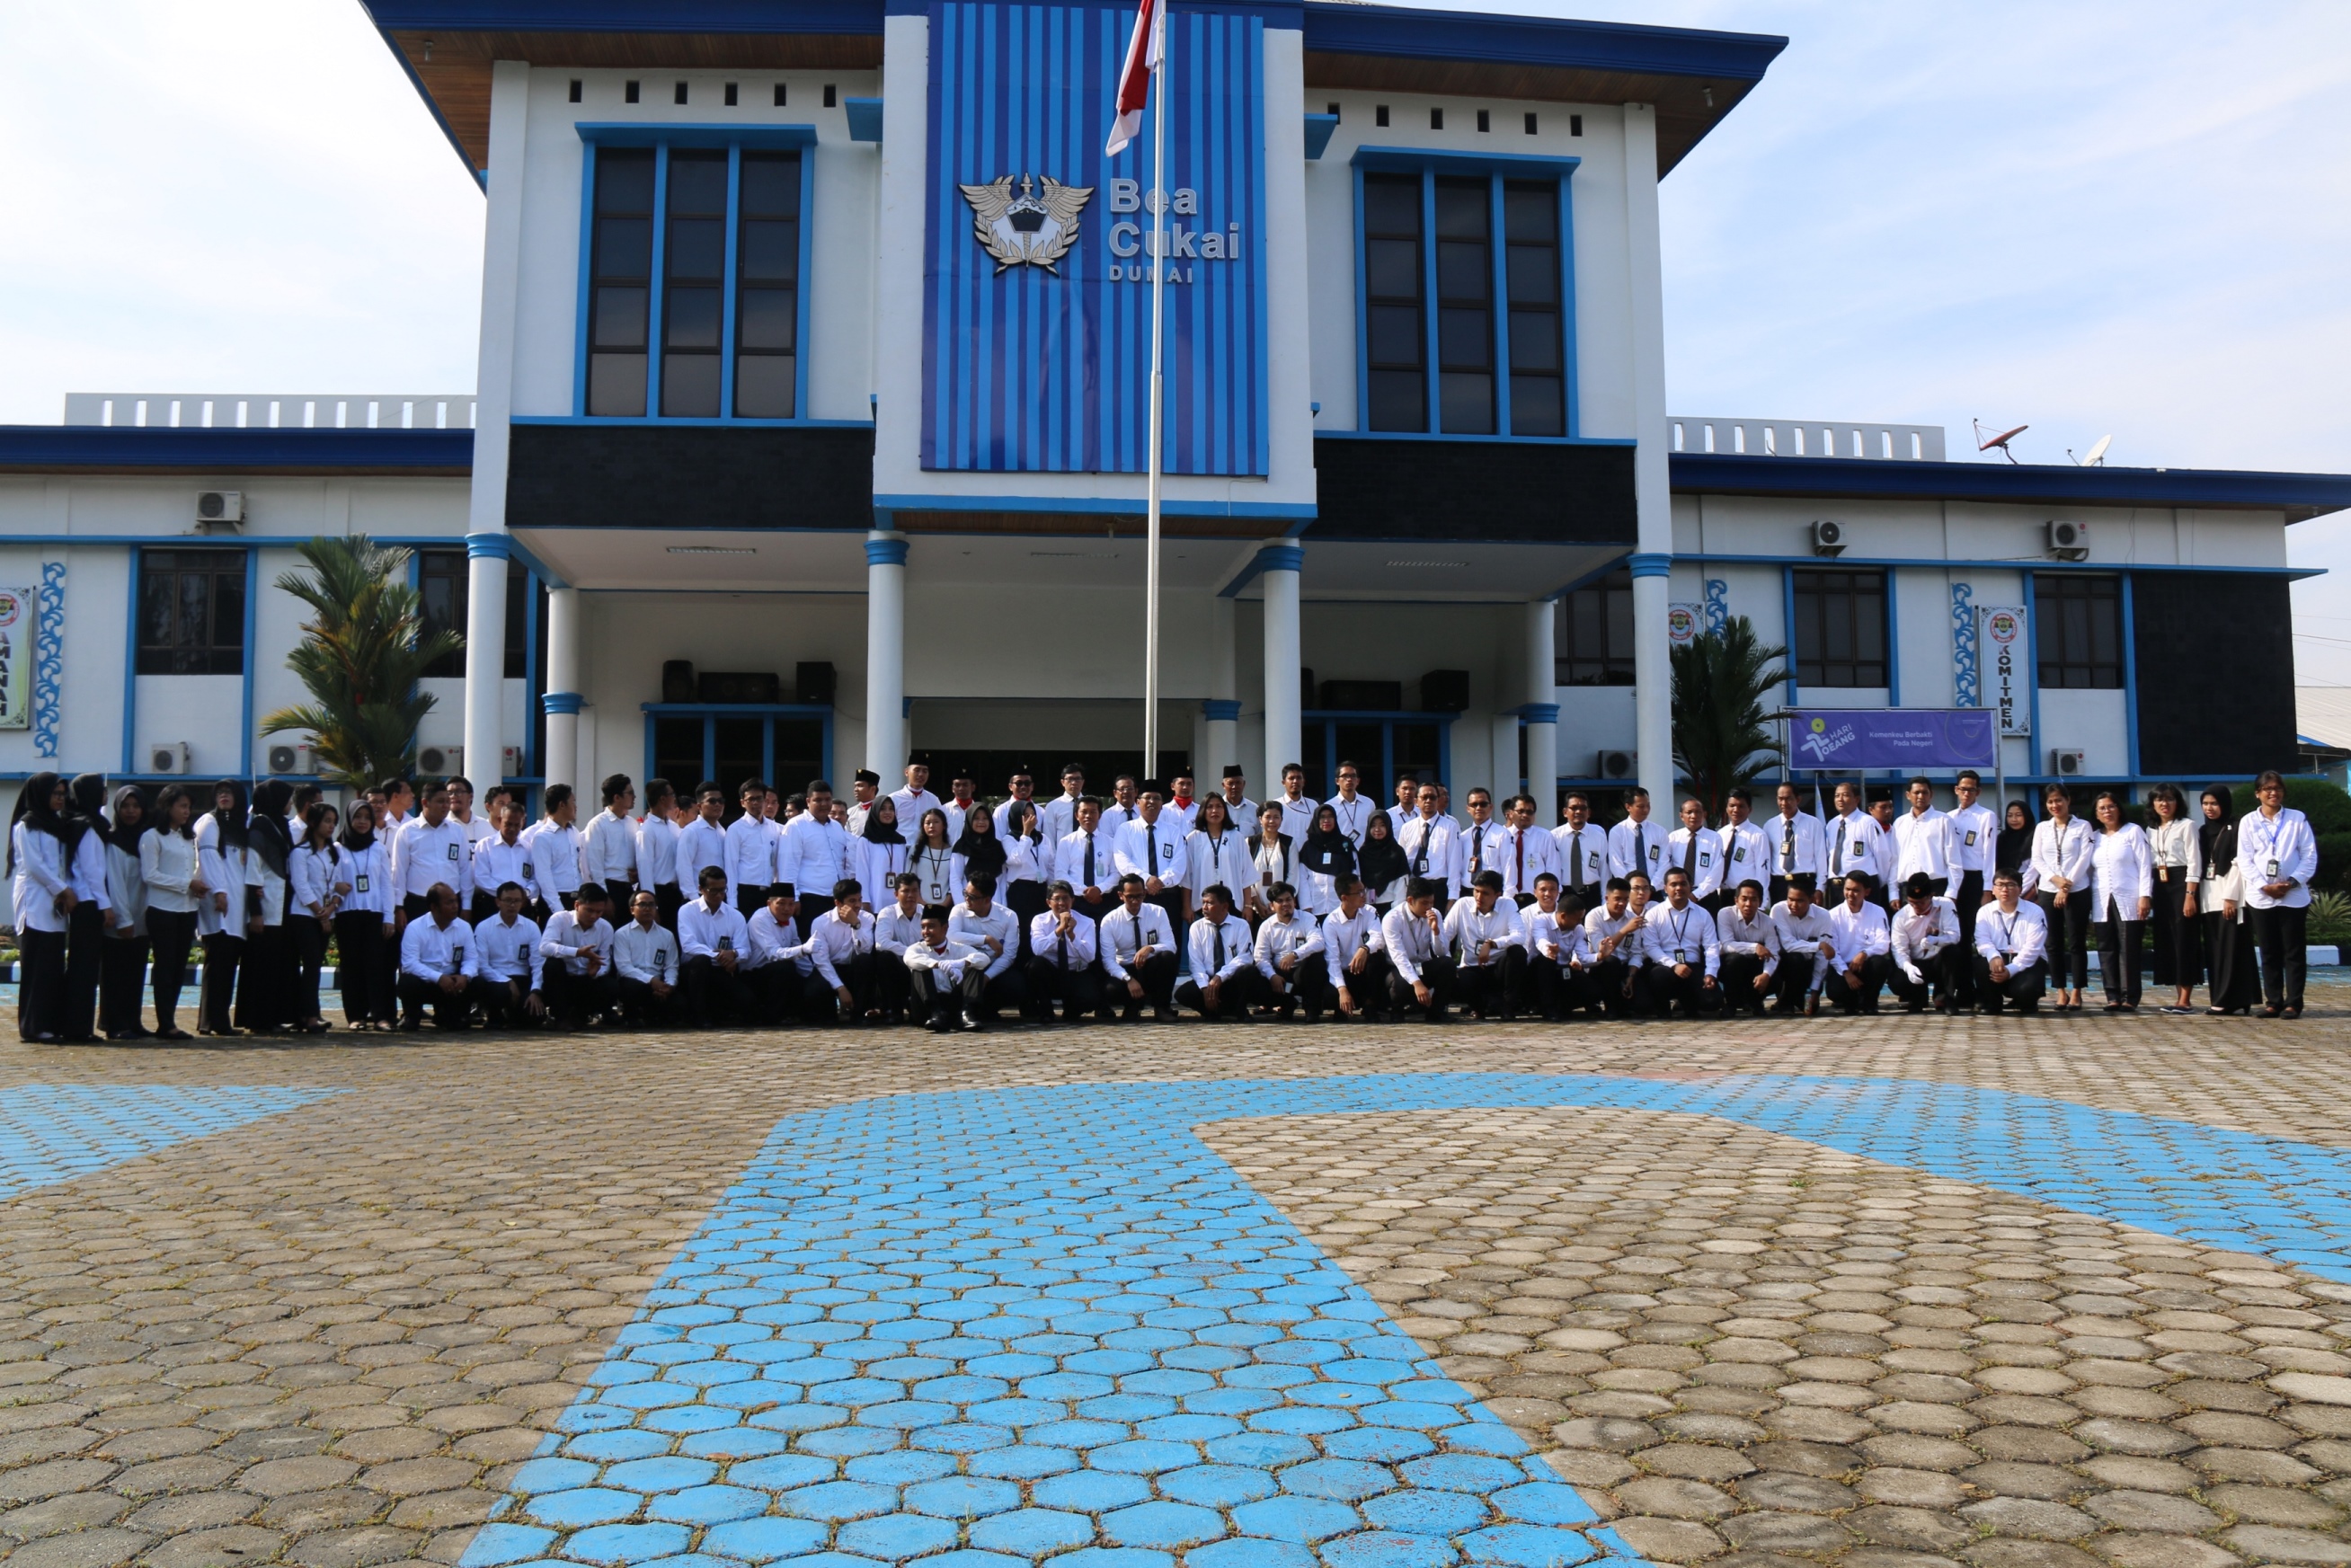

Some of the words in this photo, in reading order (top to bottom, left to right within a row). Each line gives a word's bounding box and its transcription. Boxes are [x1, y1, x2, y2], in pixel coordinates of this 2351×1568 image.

[1110, 178, 1197, 215] Bea
[1109, 222, 1238, 259] Cukai
[1998, 645, 2013, 729] KOMITMEN
[1822, 732, 1856, 755] OEANG
[1830, 723, 1852, 740] HARI
[1911, 740, 1933, 748] Negeri
